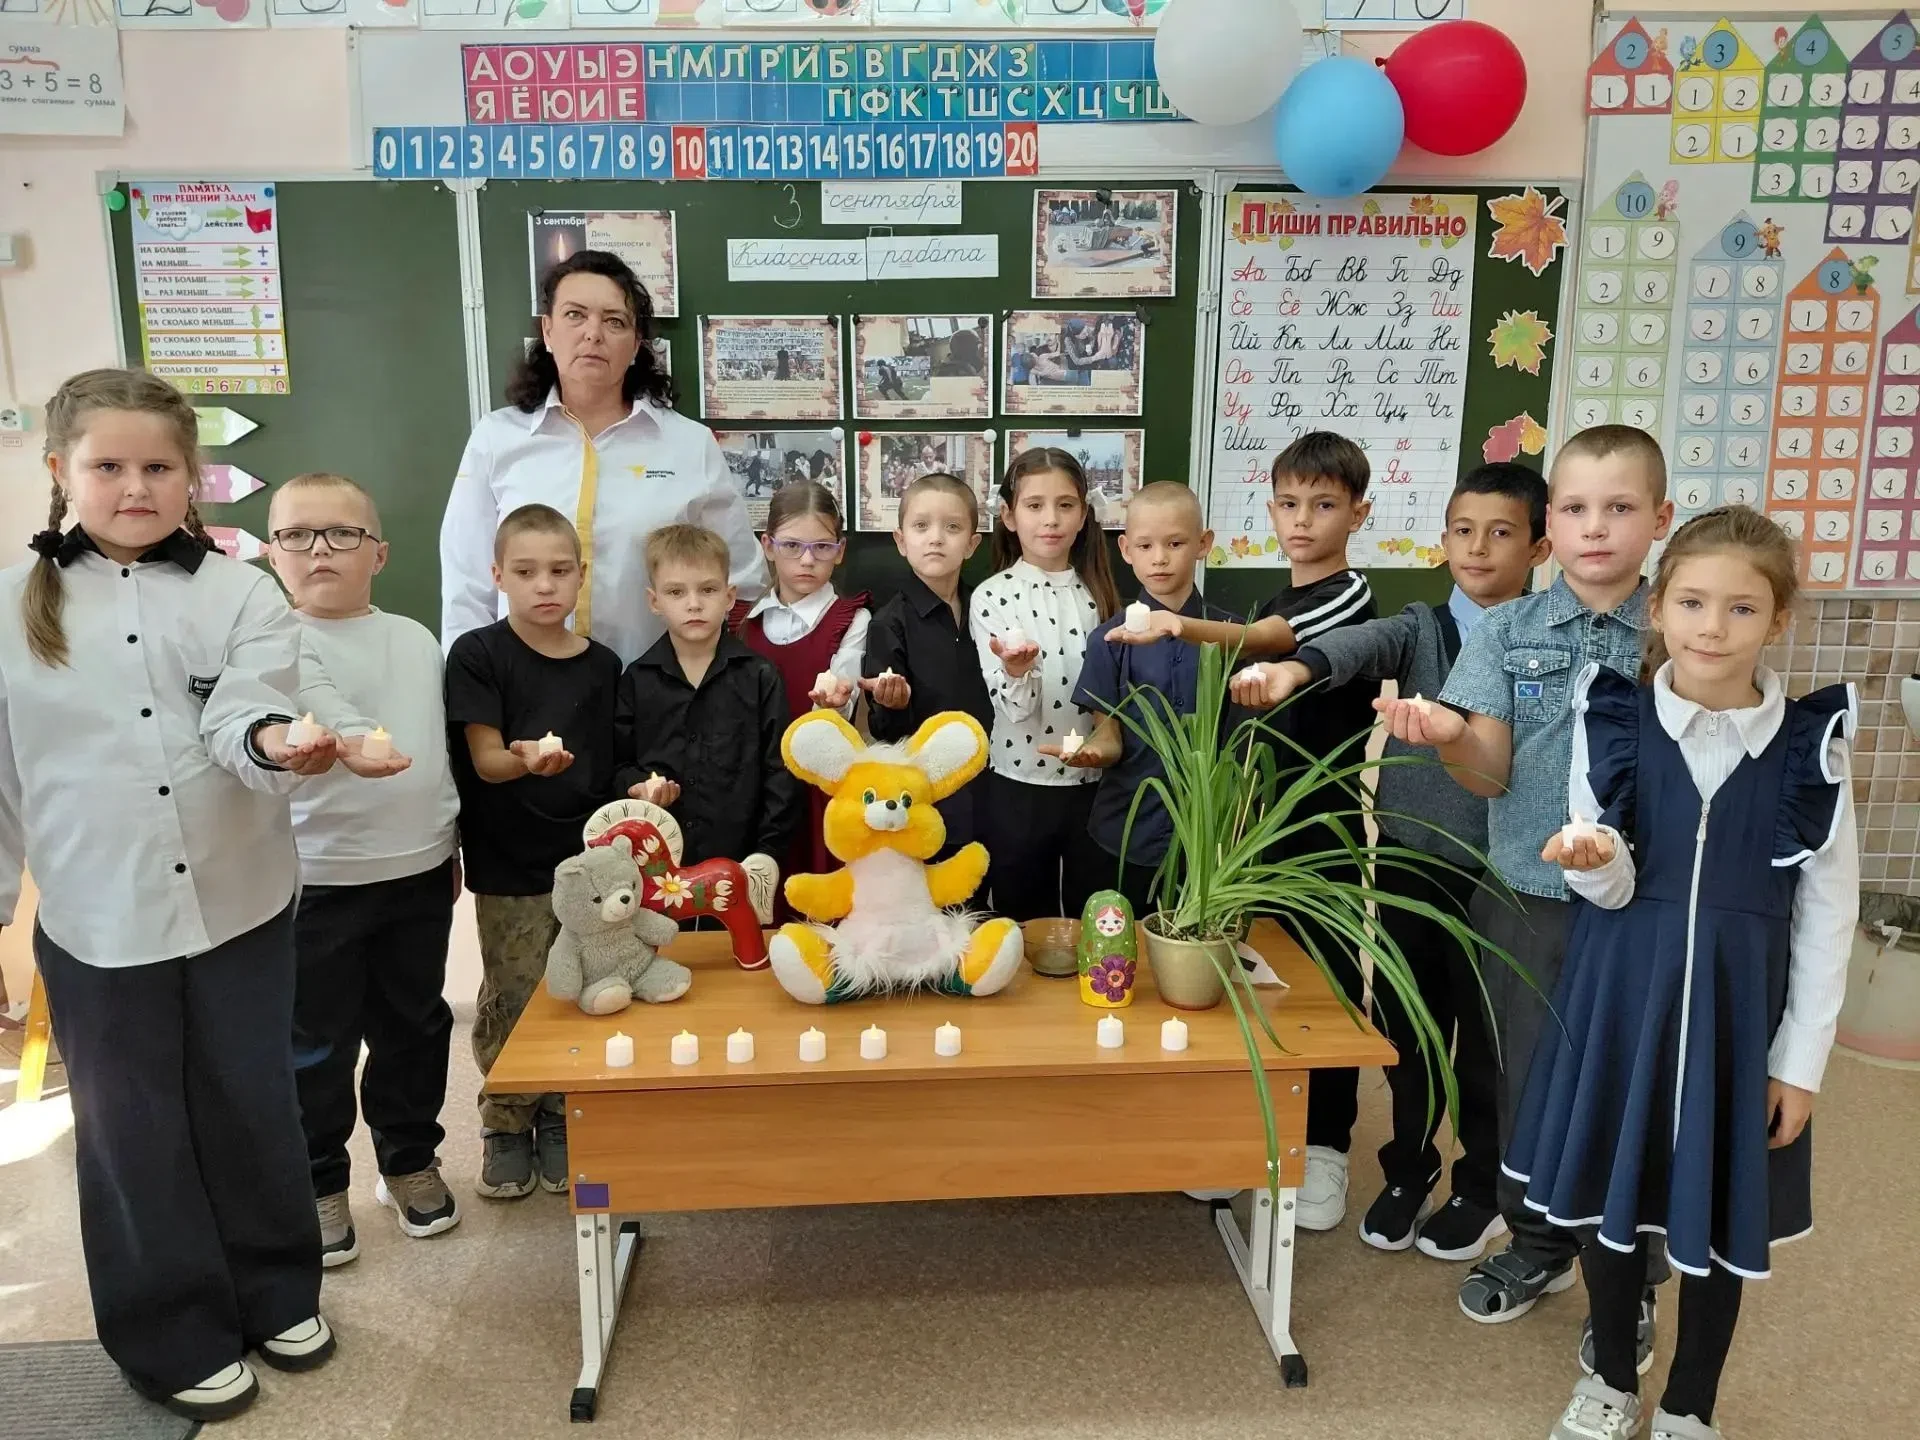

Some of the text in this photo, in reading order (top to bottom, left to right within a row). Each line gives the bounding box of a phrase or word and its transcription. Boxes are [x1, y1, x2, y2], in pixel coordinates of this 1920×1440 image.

[1625, 43, 1636, 60] 2
[1805, 39, 1816, 55] 4
[1891, 34, 1903, 51] 5
[1714, 43, 1725, 63] 3
[470, 46, 1028, 82] А О У Ы Э Н М Л Р Й Б В Г Д Ж З
[0, 69, 13, 90] 3
[45, 72, 58, 92] 5
[89, 73, 102, 94] 8
[1908, 80, 1920, 99] 4
[1734, 89, 1746, 107] 2
[1821, 84, 1833, 102] 3
[475, 90, 496, 120] Я
[512, 86, 531, 119] Ё
[542, 89, 574, 119] Ю
[580, 88, 605, 118] И
[618, 87, 637, 117] Е
[828, 88, 851, 118] П
[860, 88, 890, 117] Ф
[901, 88, 923, 117] К
[937, 88, 958, 117] Т
[967, 88, 998, 117] Ш
[1006, 87, 1029, 117] С
[1042, 87, 1066, 116] Х
[1078, 87, 1103, 118] Ц
[1114, 86, 1135, 114] Ч
[1687, 135, 1698, 153] 2
[1772, 128, 1829, 146] 2 2
[380, 131, 1037, 171] 0 1 2 3 4 5 6 7 8 9 10 11 12 13 14 15 16 17 18 19 20
[179, 184, 231, 193] ПАМЯТКА
[152, 194, 257, 203] ПРИ РЕШЕНИИ ЗАДАЧ
[773, 183, 961, 229] 3 сентября
[1626, 194, 1647, 213] 10
[535, 217, 587, 227] 3 сентября
[1653, 231, 1664, 247] 9
[1734, 234, 1746, 252] 9
[734, 238, 986, 277] Классная работа
[1232, 255, 1464, 291] Аа Бб Вв Гг Дд
[1829, 270, 1841, 289] 8
[1755, 276, 1765, 293] 8
[1231, 288, 1462, 327] Ее Ёё Жж Зз Ии
[1230, 321, 1461, 350] Йй Кк Лл Мм Нн
[1225, 358, 1458, 392] Оо Пп Рр Сс Тт
[1223, 392, 1454, 426] Уу Фф Хх Цц Чч
[1223, 426, 1267, 451] Шш
[1381, 458, 1413, 484] Яя
